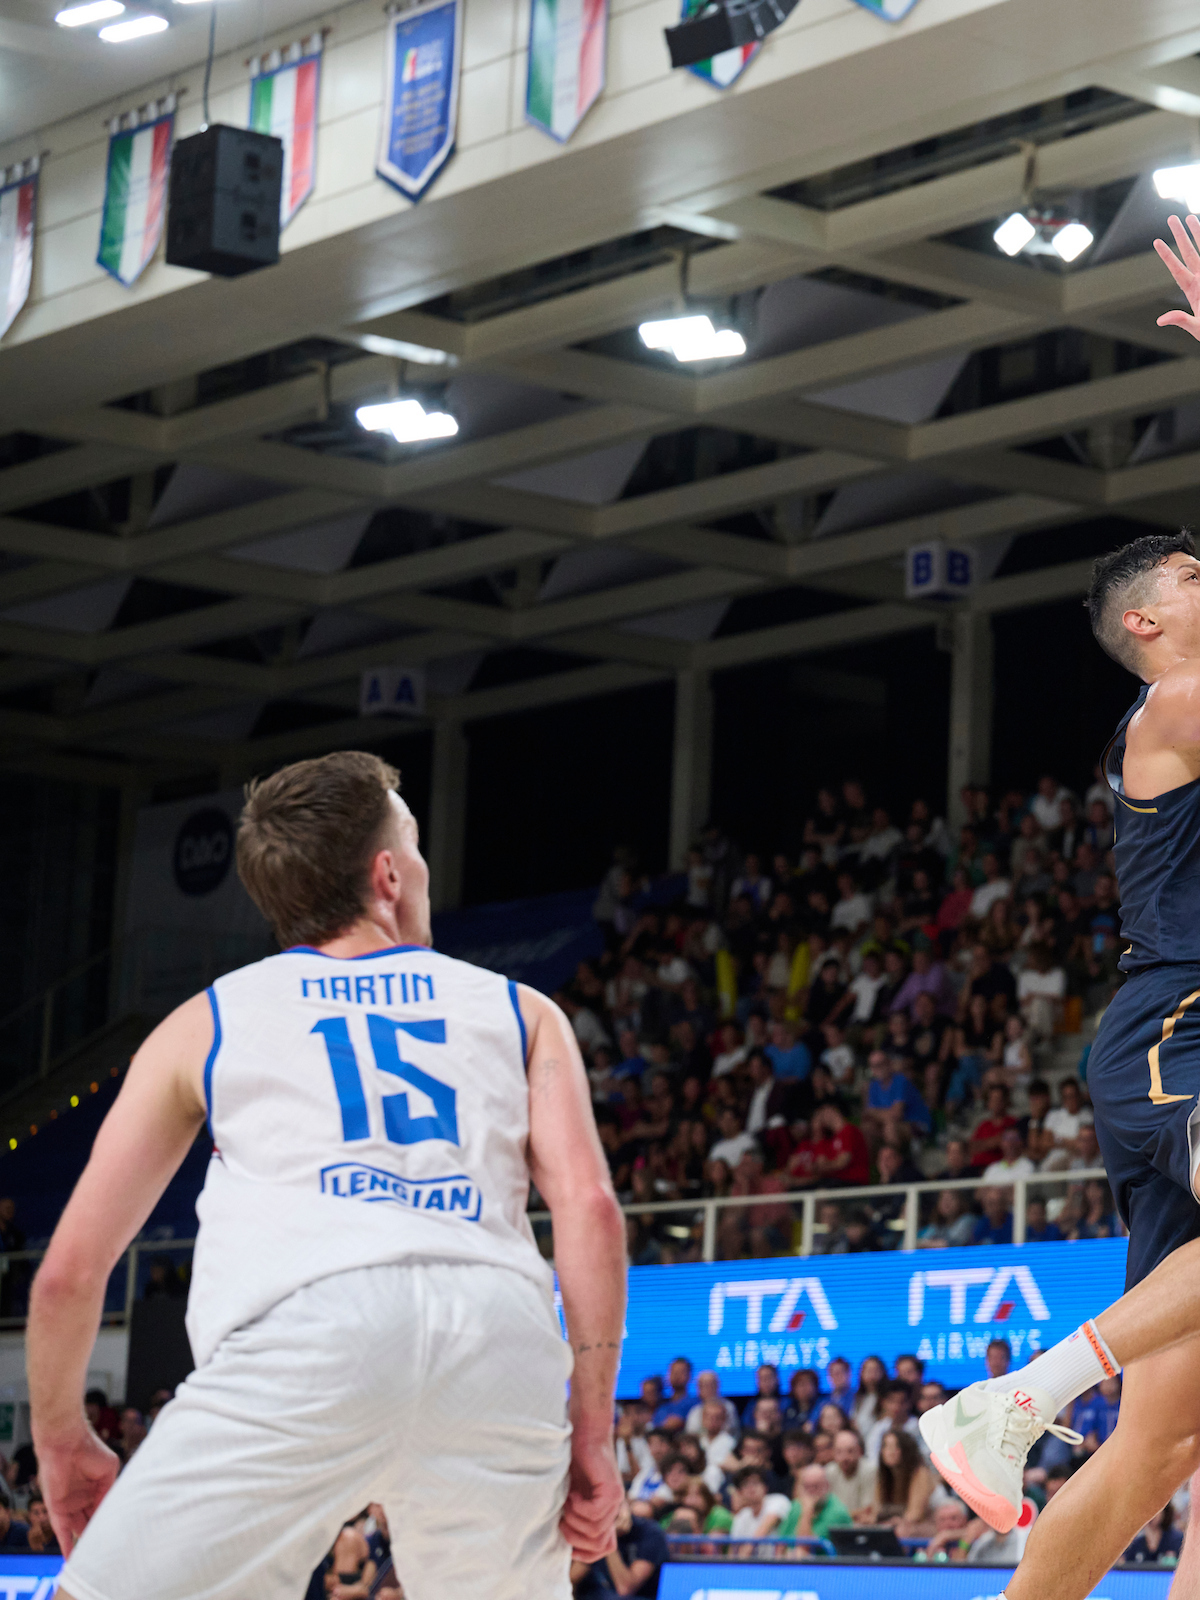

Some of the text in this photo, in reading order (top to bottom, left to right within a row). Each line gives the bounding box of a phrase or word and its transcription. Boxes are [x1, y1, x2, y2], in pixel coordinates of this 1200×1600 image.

[912, 550, 933, 587] B
[945, 548, 970, 586] B
[367, 677, 382, 704] A
[394, 676, 416, 704] A
[301, 972, 435, 1005] MARTIN
[309, 1013, 460, 1148] 15
[707, 1276, 839, 1336] ITA
[908, 1265, 1051, 1327] ITA
[714, 1336, 830, 1369] AIRWAYS
